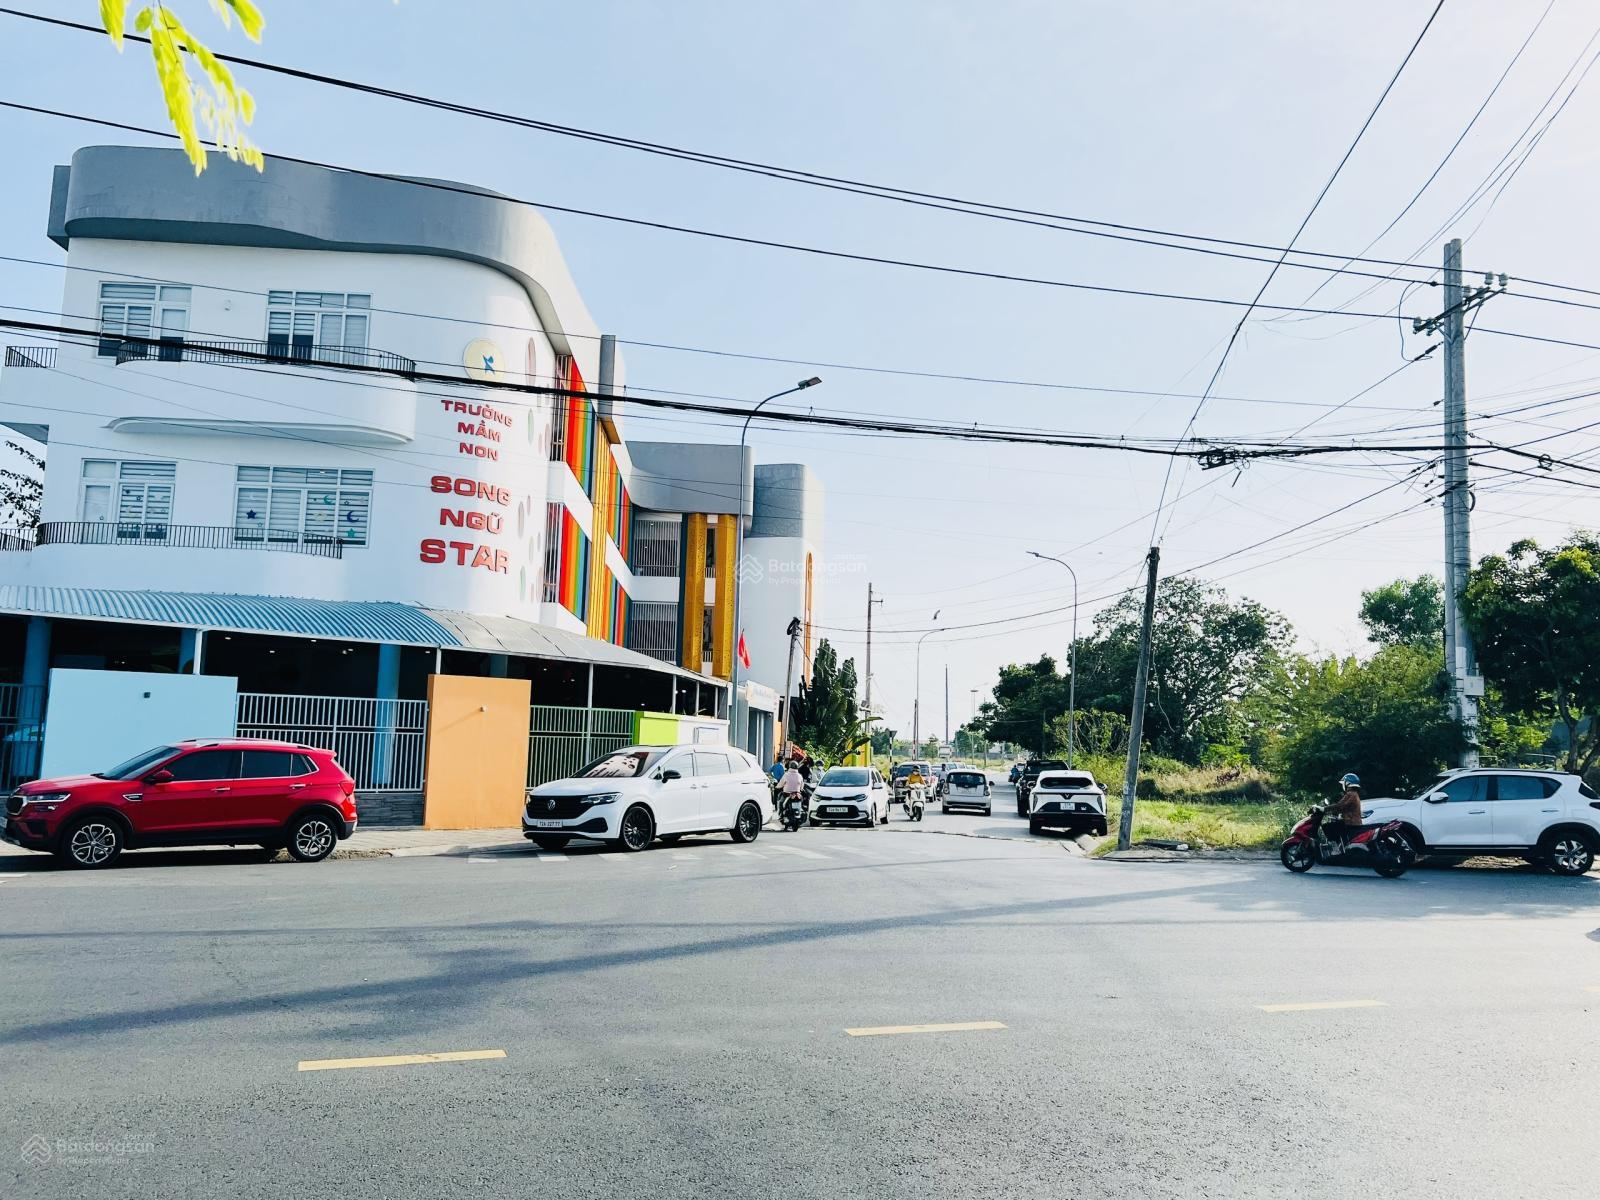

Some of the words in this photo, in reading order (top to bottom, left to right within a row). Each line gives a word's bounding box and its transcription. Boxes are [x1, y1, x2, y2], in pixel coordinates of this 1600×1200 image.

[440, 399, 513, 427] TRƯỜNG
[457, 420, 502, 442] MẦM
[459, 442, 498, 462] NON
[430, 476, 512, 507] SONG
[440, 508, 504, 535] NGỮ
[419, 539, 510, 574] STAR
